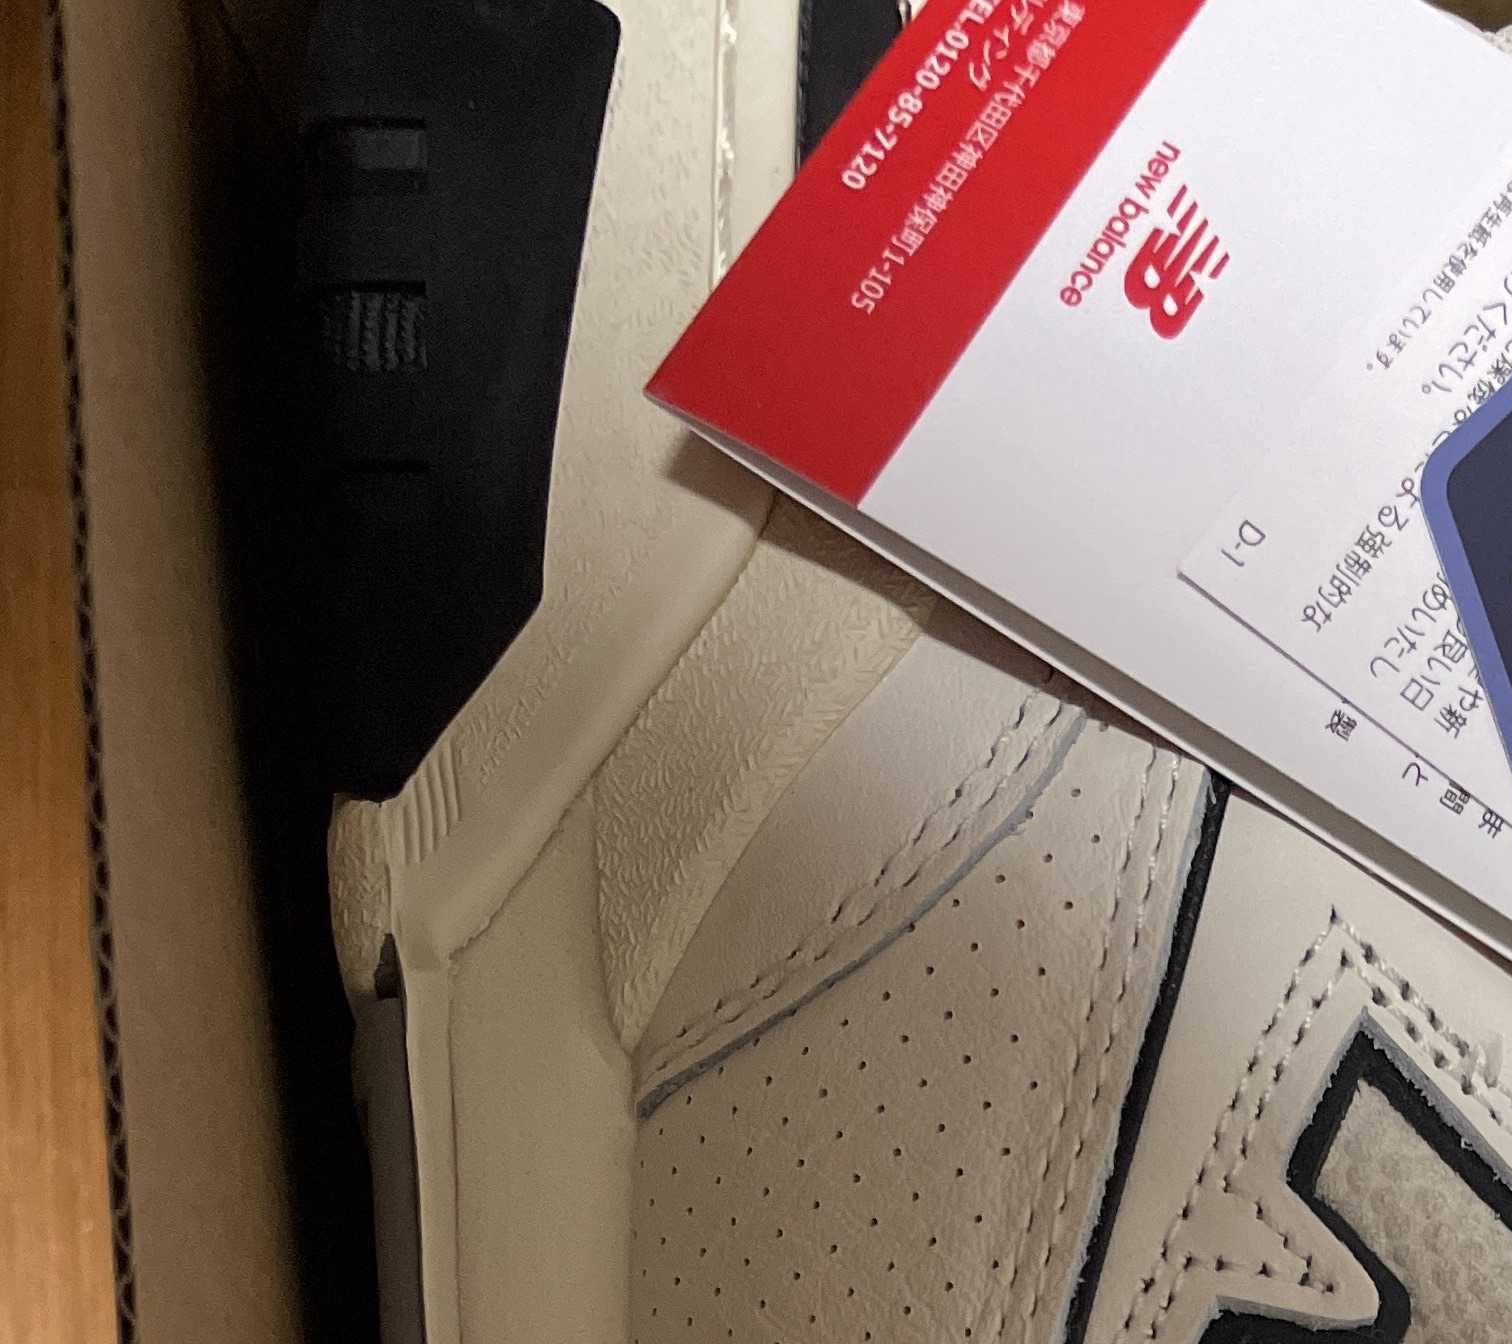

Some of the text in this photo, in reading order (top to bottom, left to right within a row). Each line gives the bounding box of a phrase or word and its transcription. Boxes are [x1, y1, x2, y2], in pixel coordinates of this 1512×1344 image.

[840, 0, 1002, 191] EL.0120-85-7120
[1058, 139, 1183, 309] new balance
[1219, 518, 1267, 568] D-1
[1368, 570, 1455, 679] めいたし
[1398, 611, 1471, 713] 良い日
[1432, 667, 1486, 741] や新
